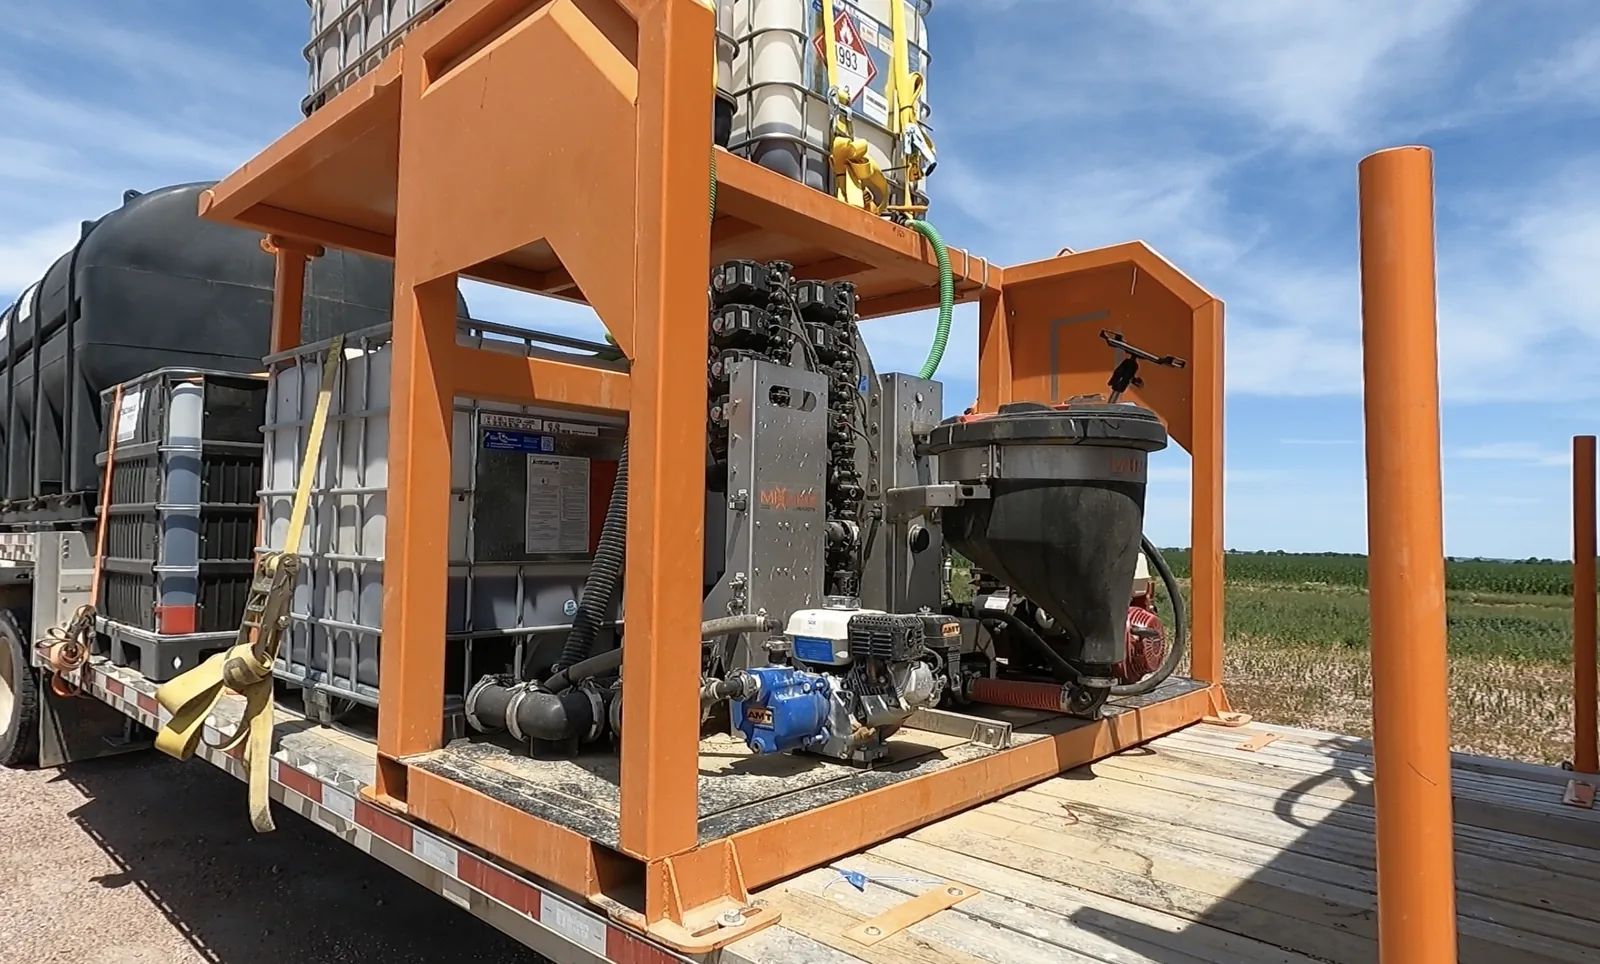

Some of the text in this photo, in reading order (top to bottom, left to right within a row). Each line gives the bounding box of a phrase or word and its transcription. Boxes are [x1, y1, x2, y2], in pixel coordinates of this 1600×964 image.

[835, 44, 858, 71] 1993
[943, 625, 960, 634] AMT
[748, 710, 772, 721] AMT
